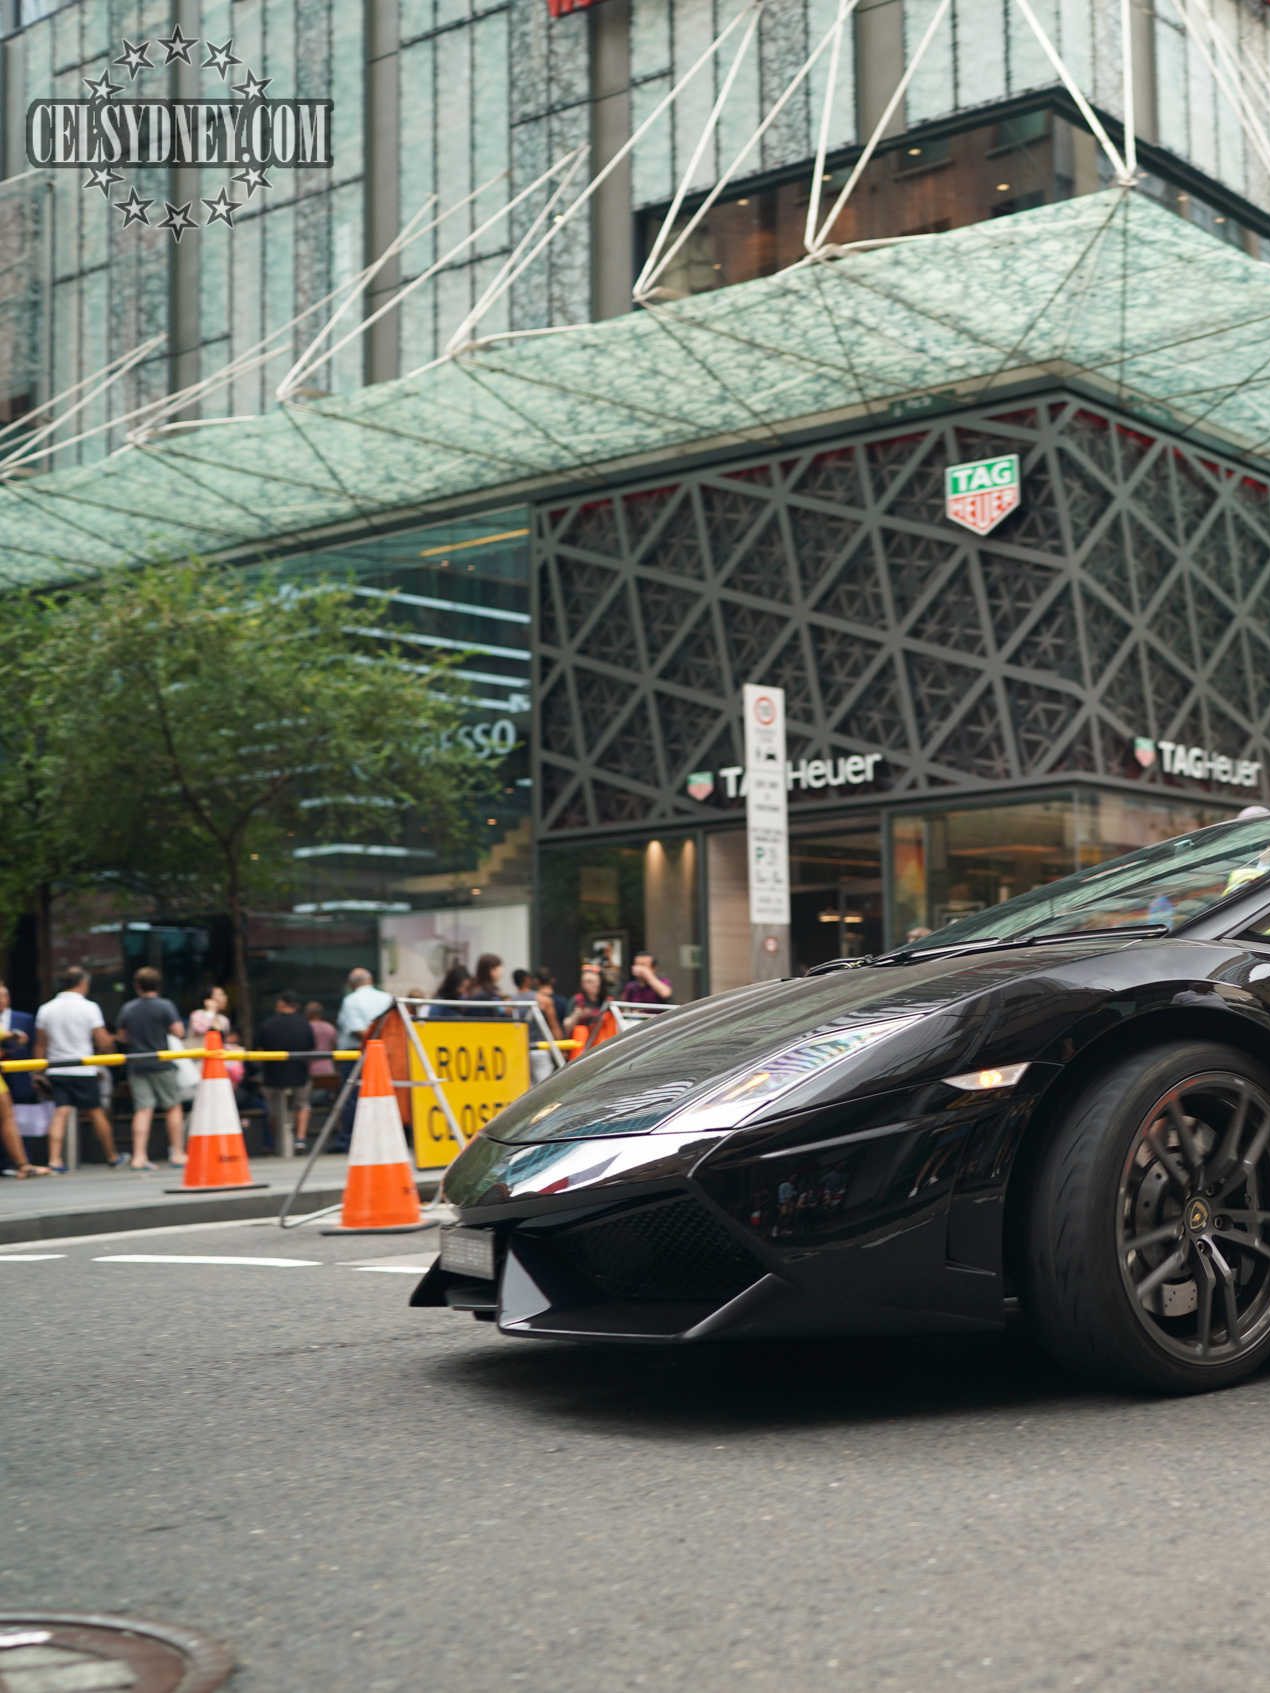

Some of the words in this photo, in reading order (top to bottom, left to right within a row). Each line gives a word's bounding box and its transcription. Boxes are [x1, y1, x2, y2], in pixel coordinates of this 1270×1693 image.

[952, 461, 1012, 491] TAG
[949, 488, 1018, 527] HEUER
[435, 1046, 508, 1081] ROAD
[427, 1102, 513, 1142] CLOS
